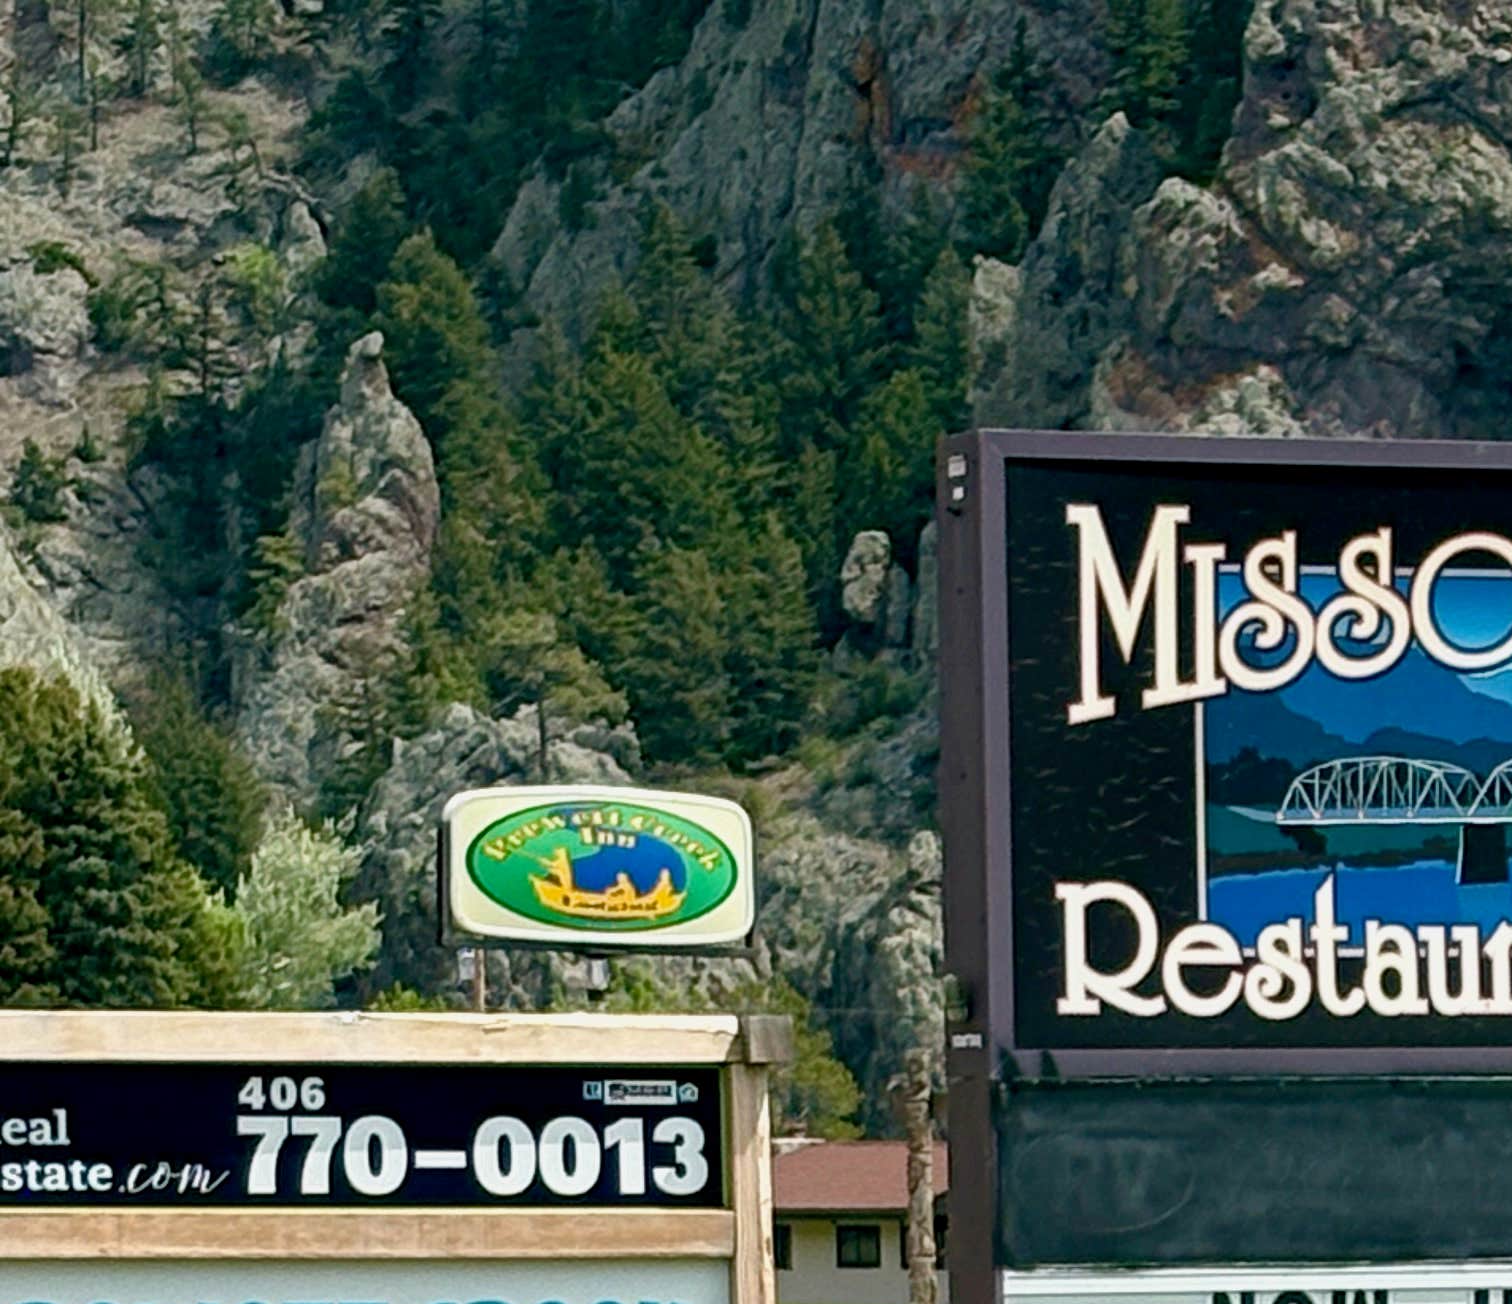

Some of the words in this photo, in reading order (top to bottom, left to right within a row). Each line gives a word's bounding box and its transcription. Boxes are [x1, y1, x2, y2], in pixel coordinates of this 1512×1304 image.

[579, 826, 637, 849] Inn
[238, 1076, 326, 1111] 406
[0, 1108, 71, 1146] eal
[236, 1115, 709, 1196] 770-0013
